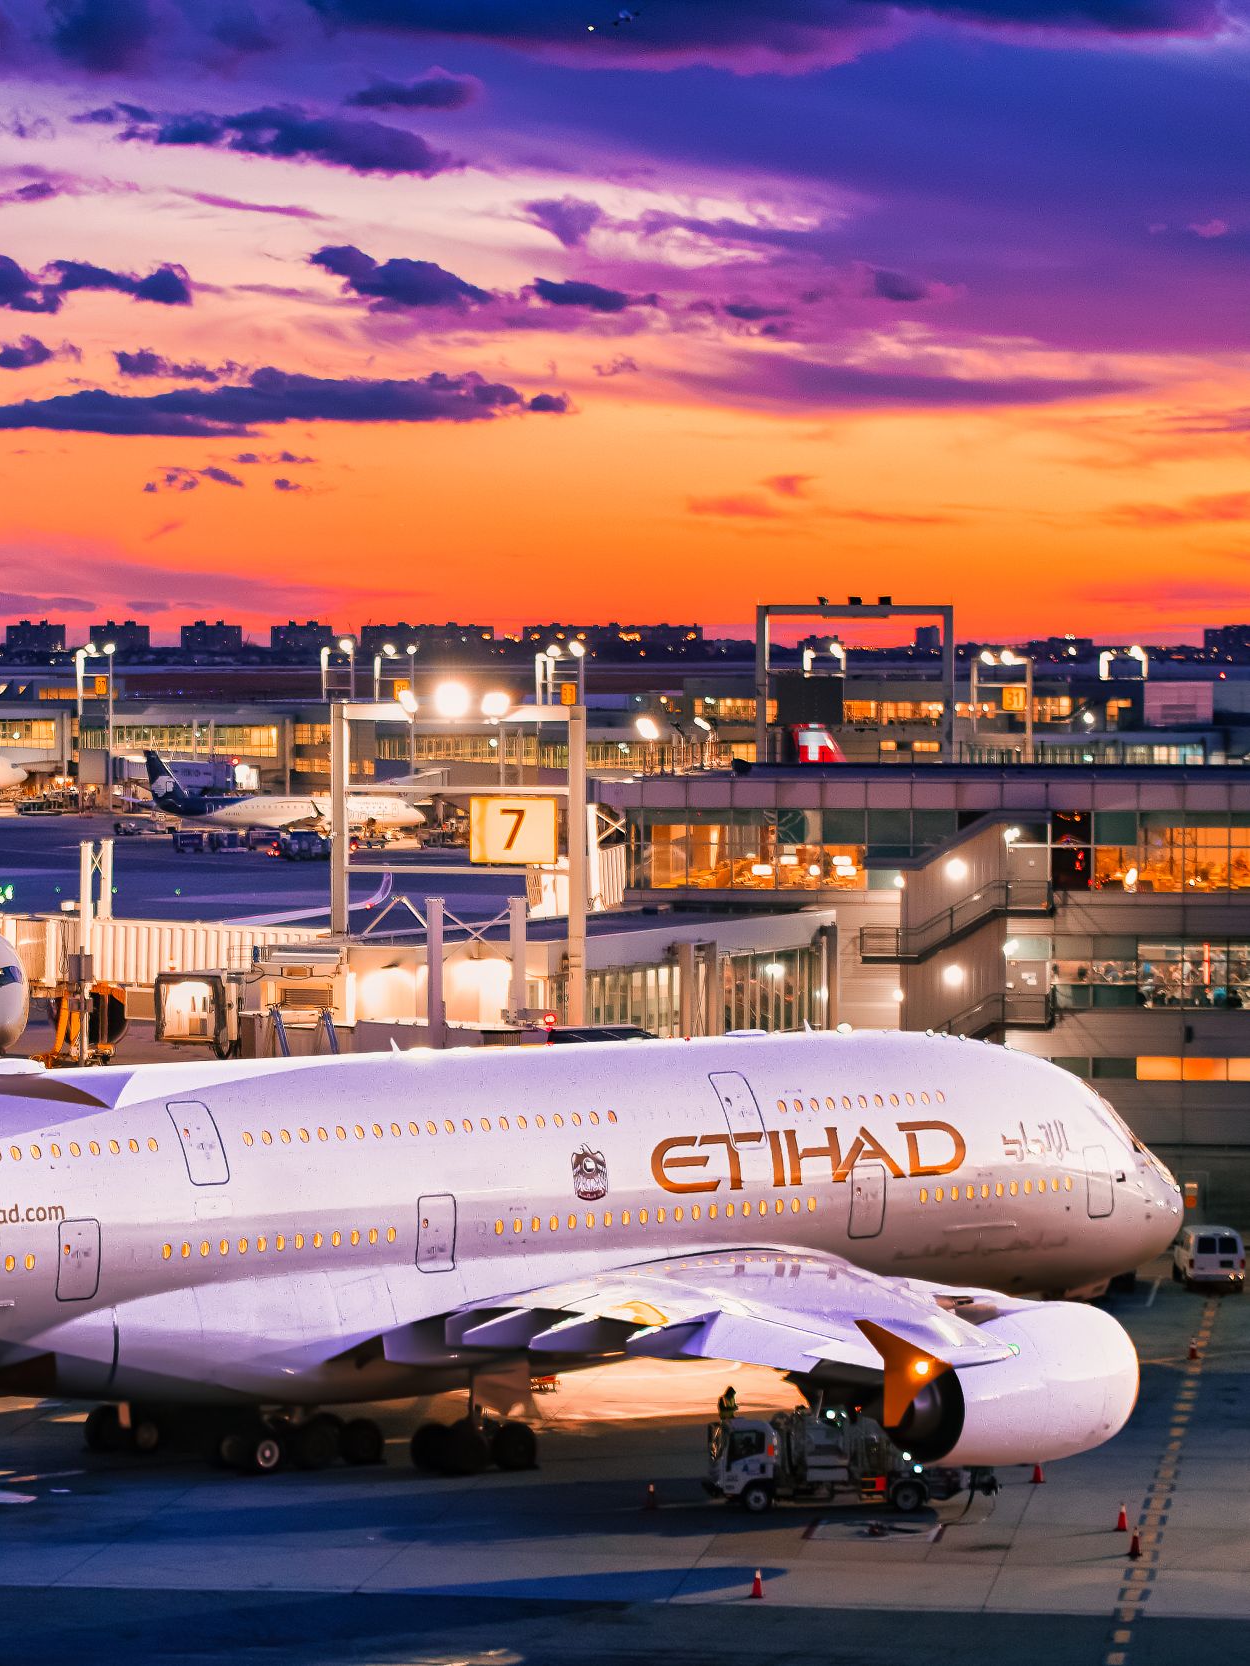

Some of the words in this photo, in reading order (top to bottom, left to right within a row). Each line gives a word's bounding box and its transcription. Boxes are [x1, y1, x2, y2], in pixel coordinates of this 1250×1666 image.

[1007, 692, 1020, 706] 31
[500, 808, 526, 850] 7
[650, 1120, 967, 1194] ETIHAD
